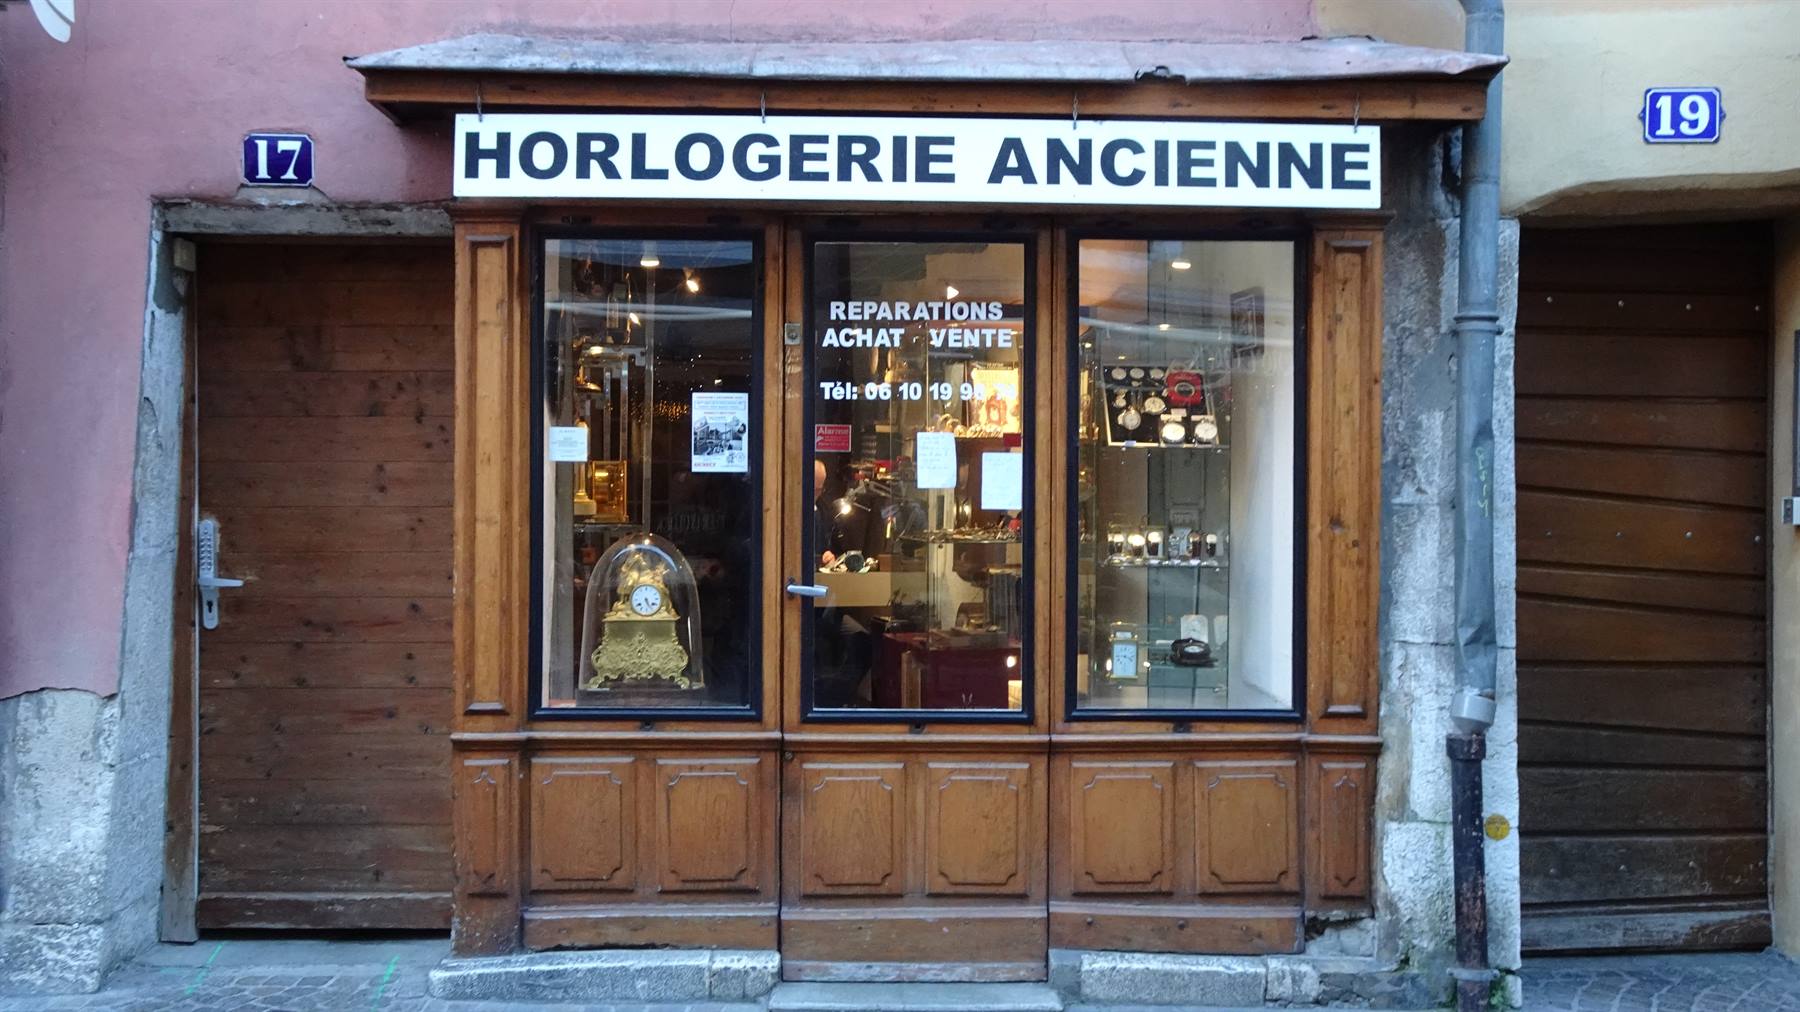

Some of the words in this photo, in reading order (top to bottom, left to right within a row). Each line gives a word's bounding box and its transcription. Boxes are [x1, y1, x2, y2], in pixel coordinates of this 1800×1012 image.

[1655, 94, 1710, 136] 19
[254, 140, 302, 179] 17
[464, 131, 955, 183] HORLOGERIE
[987, 137, 1371, 190] ANCIENNE
[830, 301, 1003, 321] REPARATIONS
[822, 328, 904, 348] ACHAT
[929, 328, 1012, 348] VENTE
[820, 381, 857, 400] Tél:
[864, 382, 892, 400] 06
[899, 382, 922, 400] 10
[929, 382, 952, 400] 19
